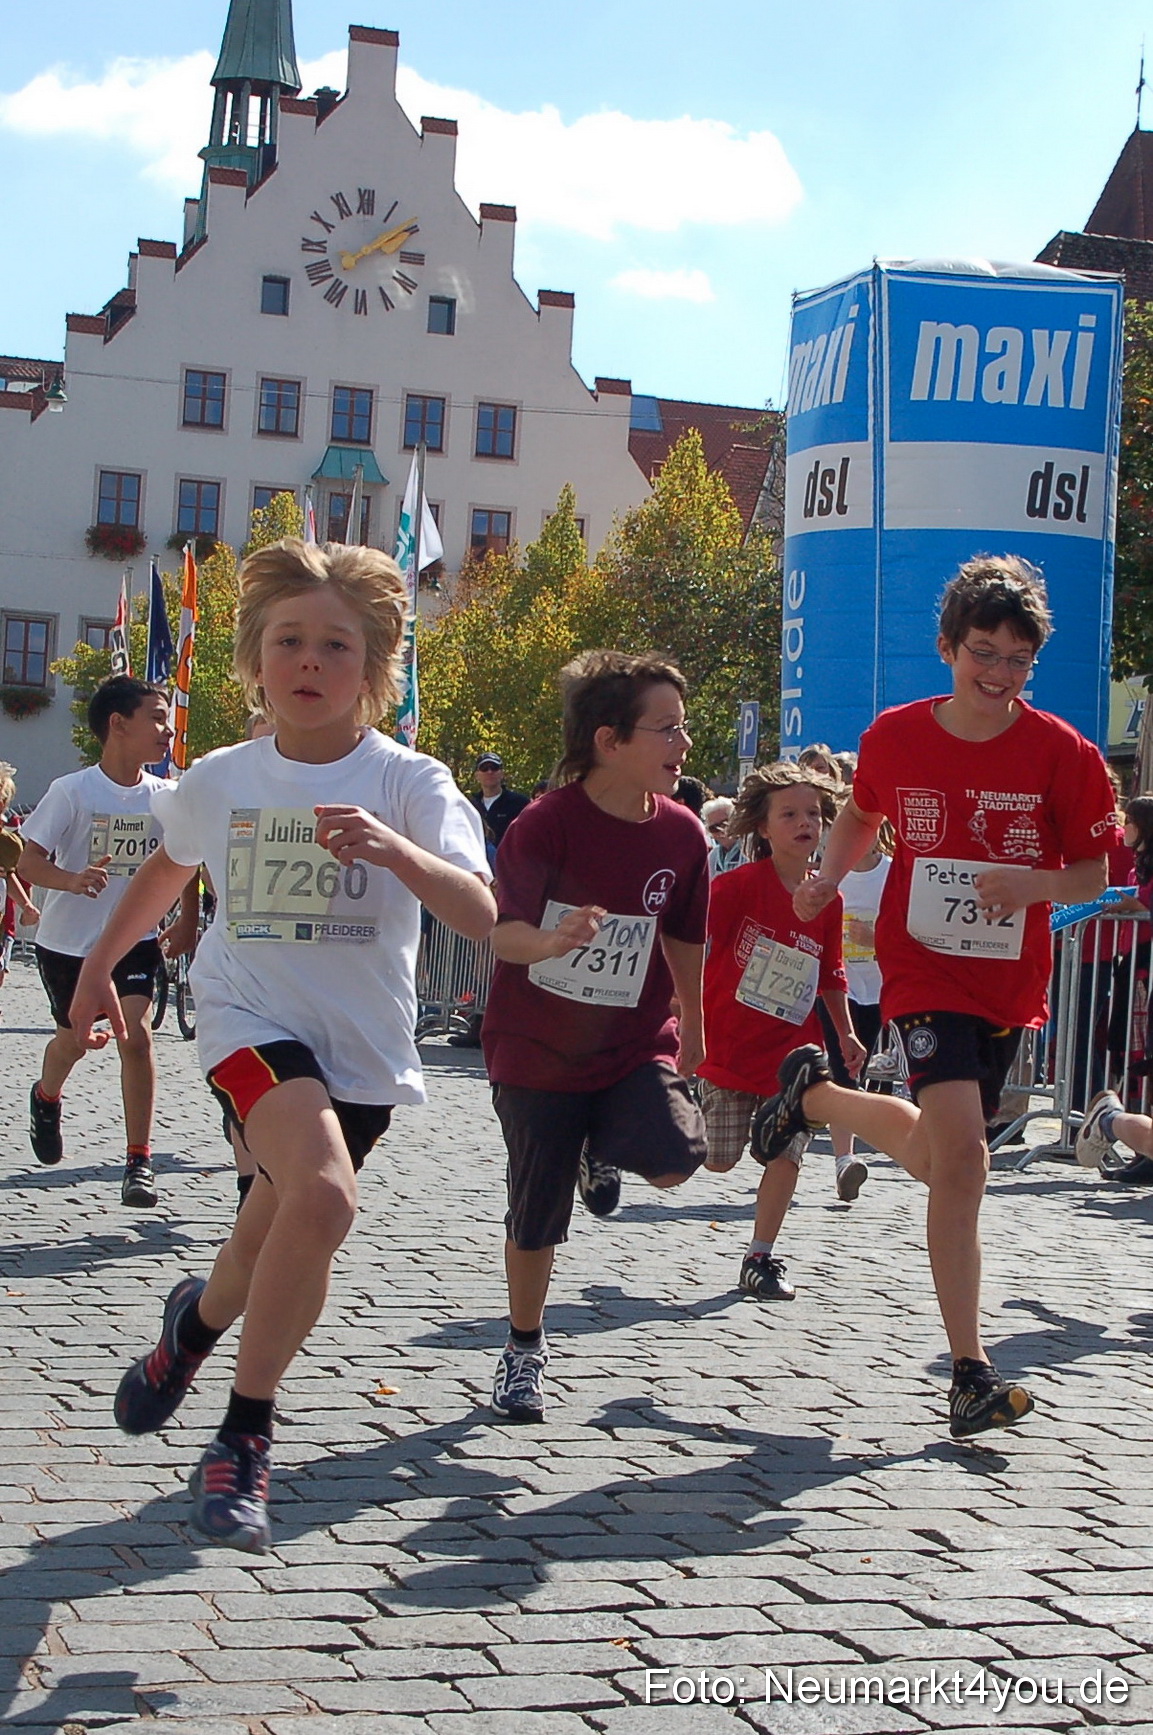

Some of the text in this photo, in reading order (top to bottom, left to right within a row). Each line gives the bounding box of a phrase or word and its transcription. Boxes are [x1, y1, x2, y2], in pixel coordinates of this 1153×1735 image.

[330, 191, 353, 220] XI
[356, 187, 375, 216] XII
[383, 200, 398, 223] I
[310, 210, 336, 233] X
[301, 237, 328, 253] IX
[399, 251, 426, 266] III
[304, 259, 334, 287] VIII
[392, 270, 418, 295] IV
[323, 278, 348, 308] VII
[354, 288, 368, 316] VI
[379, 286, 395, 312] V
[787, 304, 859, 419] maxi
[910, 313, 1097, 411] maxi
[803, 456, 850, 519] dsl
[1026, 461, 1090, 524] dsl
[743, 709, 754, 750] P
[904, 797, 938, 807] IMMER
[965, 789, 1043, 804] 11. NEUMARKTE
[977, 799, 1036, 812] STADTLAUF
[114, 819, 144, 832] Ahmet
[265, 817, 318, 843] Julia
[905, 832, 938, 842] MARKT
[906, 817, 937, 832] NEU
[114, 838, 159, 856] 7019
[231, 859, 368, 900] K 7260
[314, 924, 376, 937] PFLEIDERER
[570, 945, 639, 977] 7311
[775, 949, 806, 971] David
[767, 971, 814, 1003] 7262
